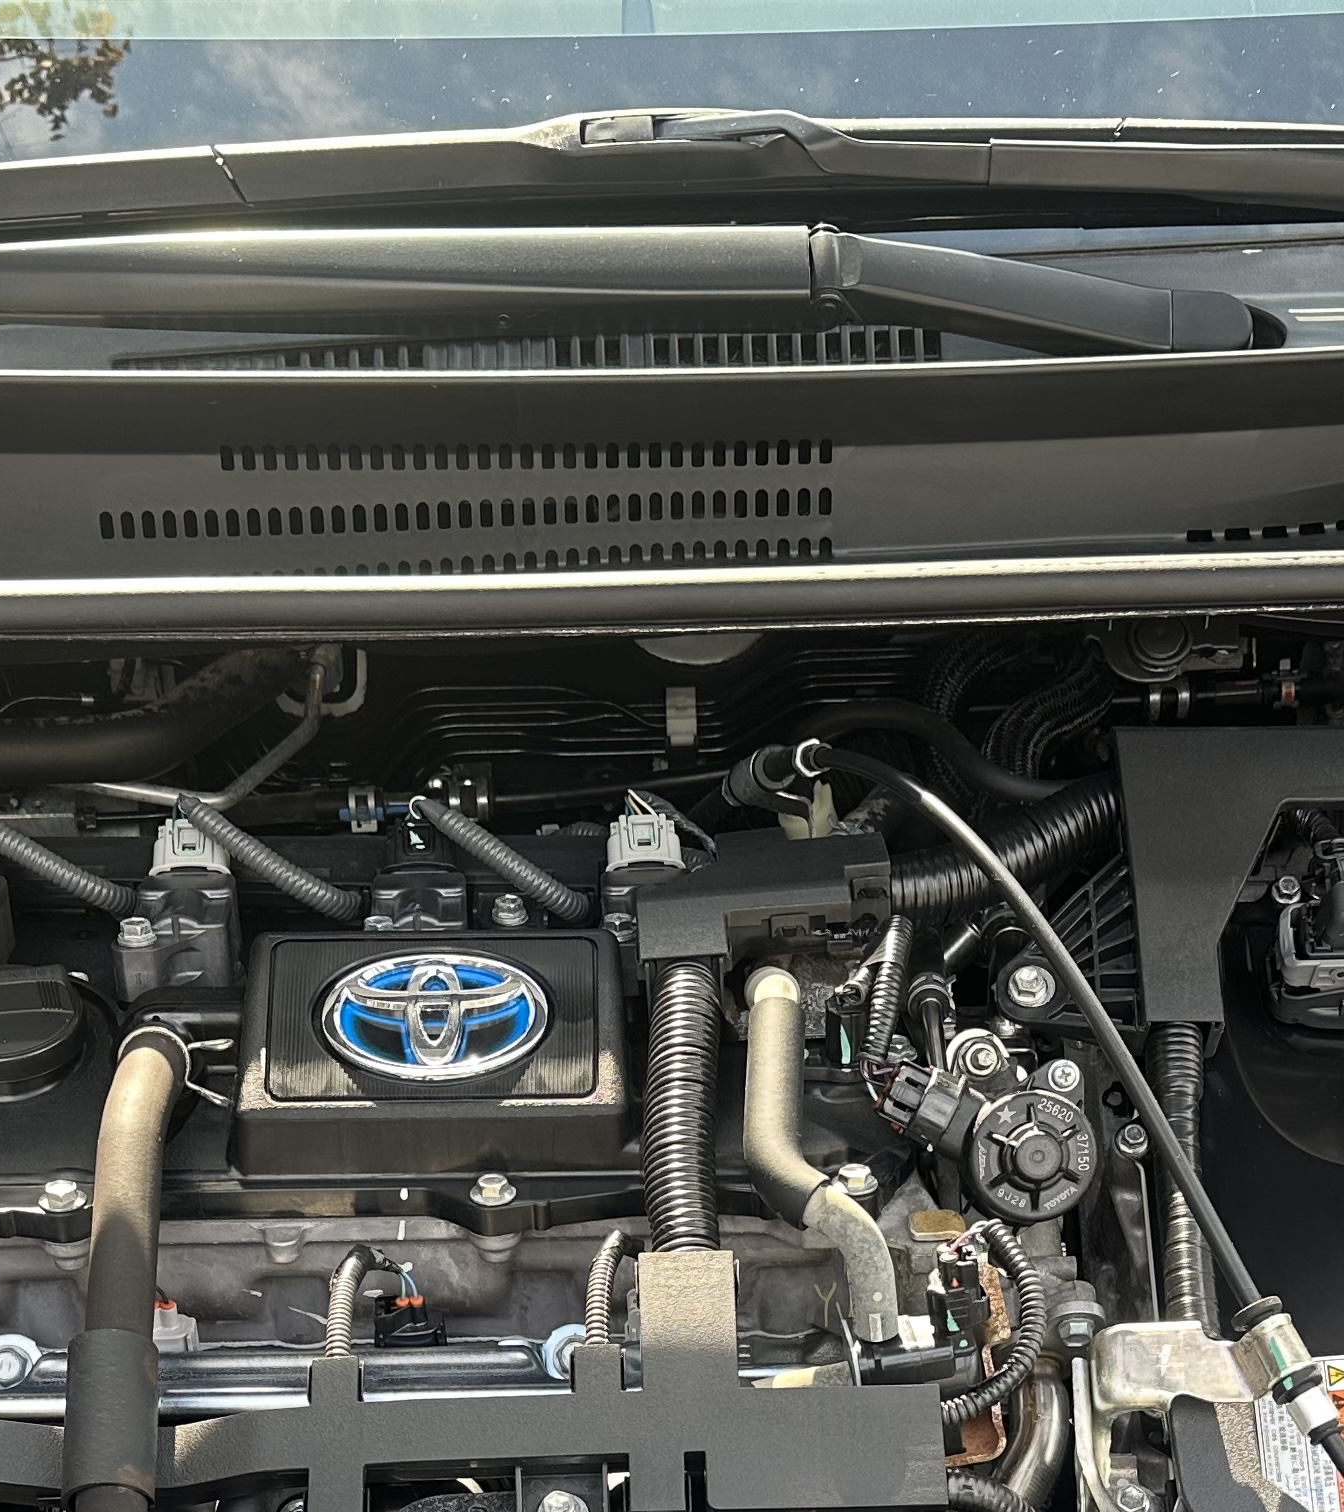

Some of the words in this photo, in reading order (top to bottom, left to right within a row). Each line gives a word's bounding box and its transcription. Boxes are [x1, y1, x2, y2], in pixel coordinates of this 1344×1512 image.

[1037, 1098, 1074, 1123] 25620
[1076, 1133, 1090, 1171] 37150
[1043, 1185, 1078, 1211] TOYOTA
